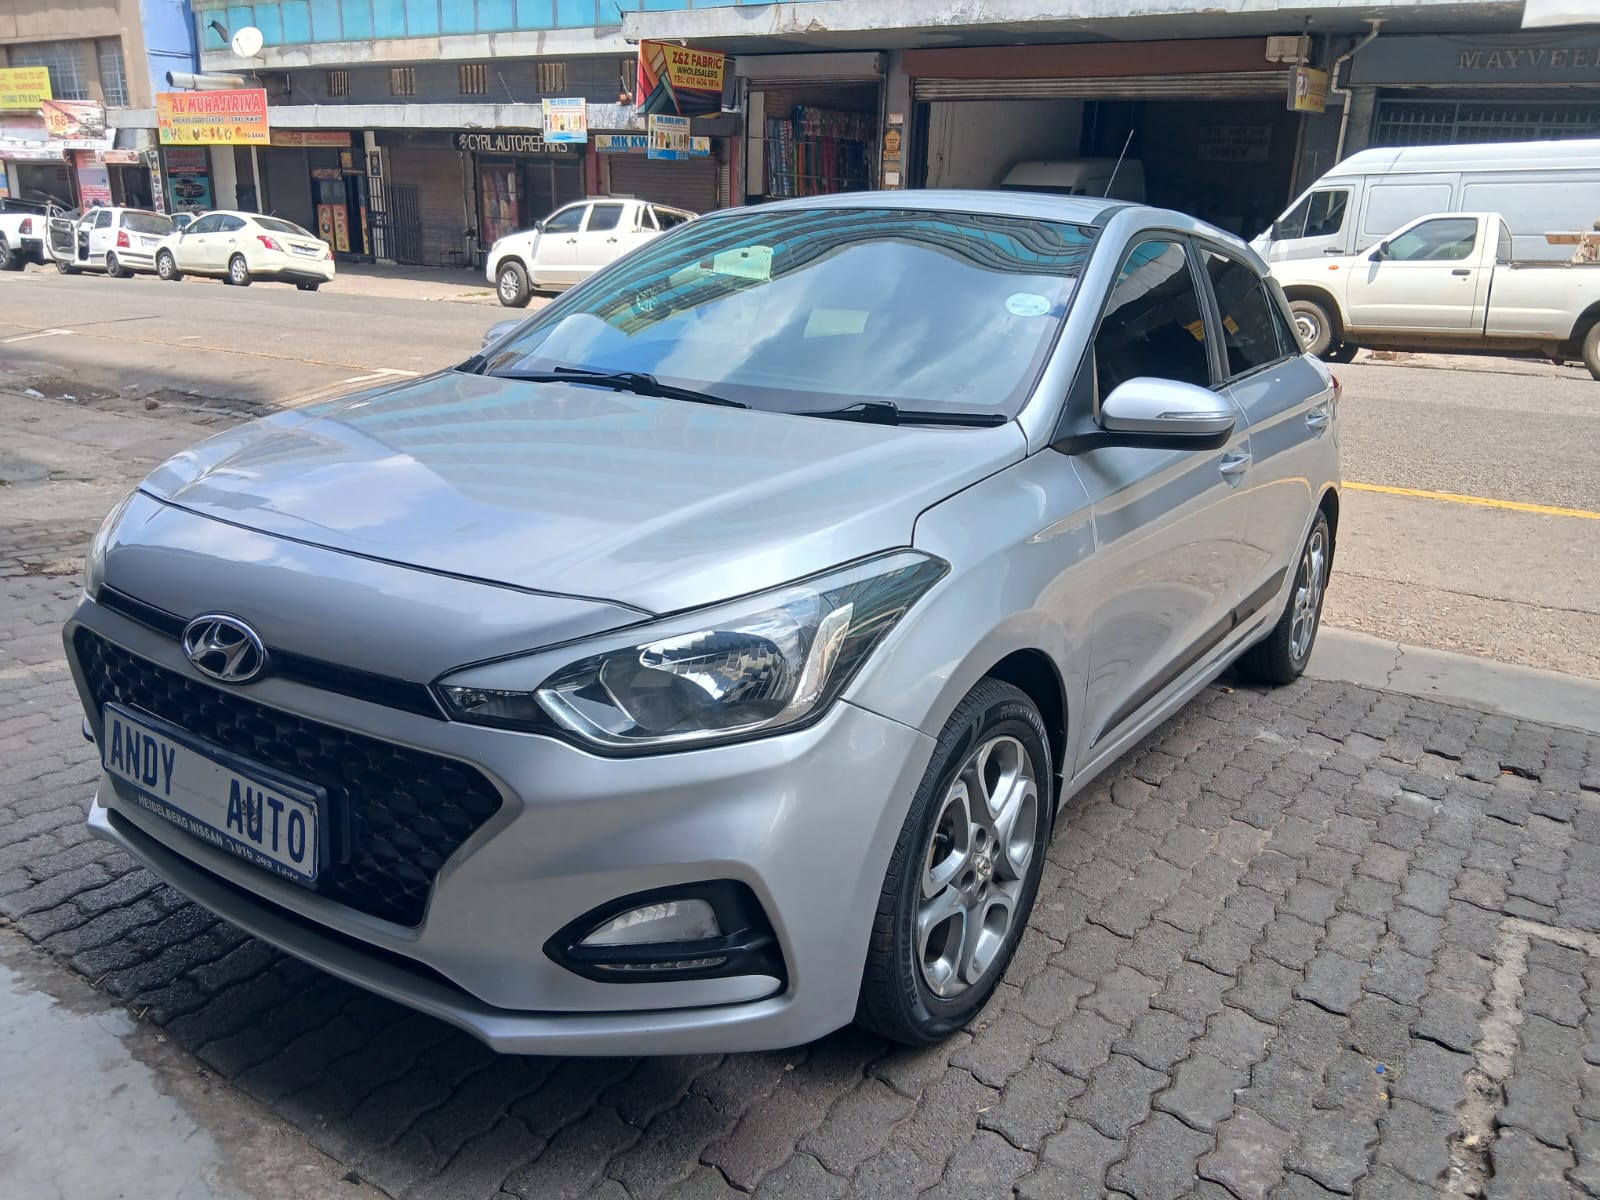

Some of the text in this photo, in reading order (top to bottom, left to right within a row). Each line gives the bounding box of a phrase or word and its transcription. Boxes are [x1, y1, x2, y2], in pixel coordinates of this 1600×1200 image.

[691, 55, 722, 70] FABRIC
[677, 66, 719, 79] WHOLESALERS
[686, 76, 695, 86] 011
[172, 94, 262, 113] AL MUHAJIRINA
[611, 135, 648, 148] MK KW
[111, 719, 306, 863] ANDY AUTO
[137, 793, 189, 829] HEIDELBERG
[189, 820, 224, 846] NISSAN
